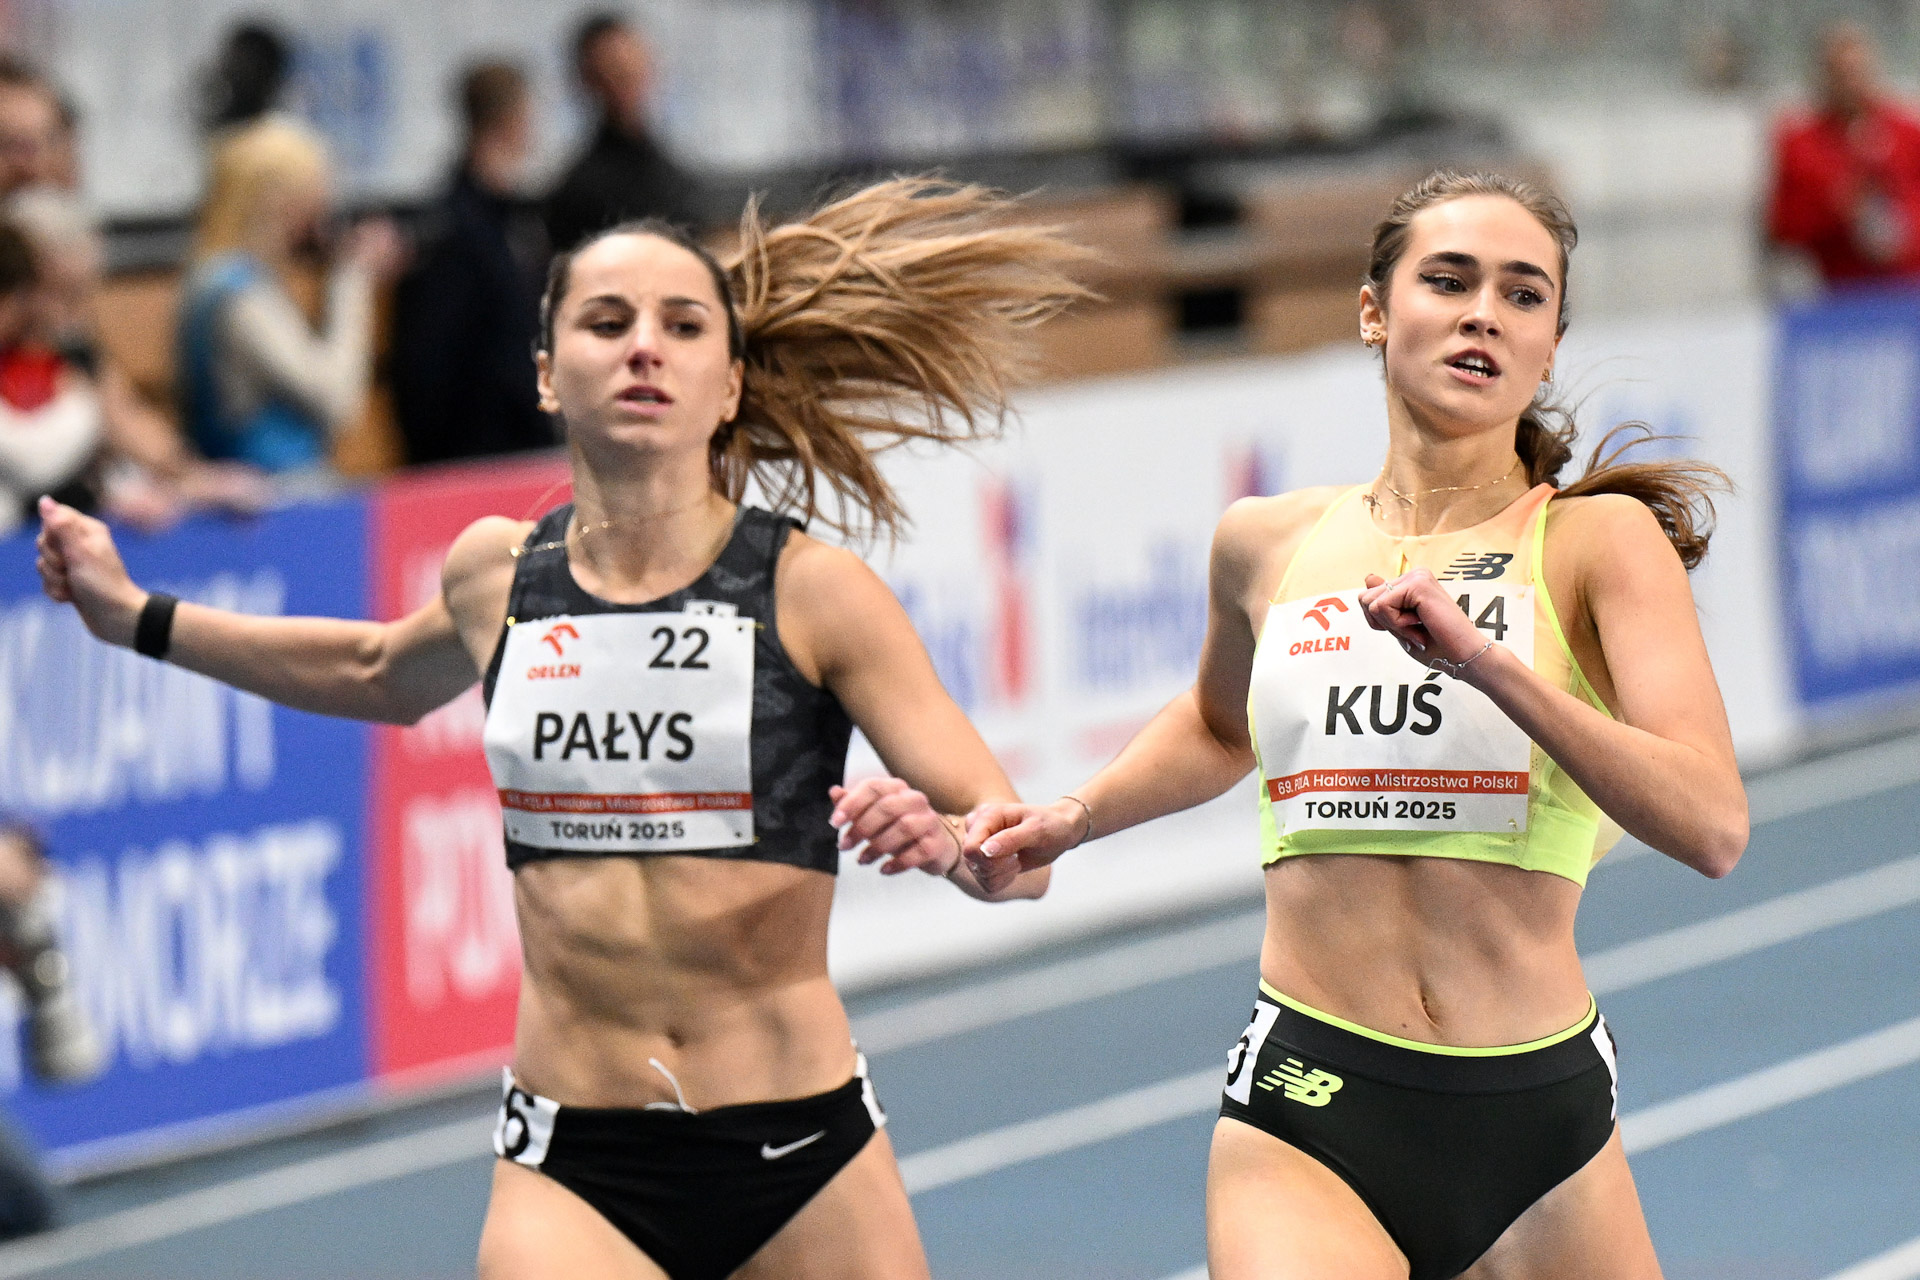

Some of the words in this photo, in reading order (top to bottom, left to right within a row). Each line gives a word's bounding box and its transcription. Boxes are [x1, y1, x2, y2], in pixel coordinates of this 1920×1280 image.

[649, 626, 710, 670] 22
[1289, 636, 1350, 656] ORLEN
[527, 664, 581, 681] ORLEN
[1325, 672, 1443, 736] KUŚ
[532, 711, 695, 762] PAŁYS
[1277, 780, 1294, 795] 69.
[1313, 773, 1371, 787] Halowe
[1374, 773, 1469, 790] Mistrzostwa
[1473, 774, 1518, 789] Polski
[1305, 795, 1389, 819] TORUŃ
[1394, 801, 1457, 820] 2025
[550, 814, 622, 840] TORUŃ
[629, 820, 685, 840] 2025
